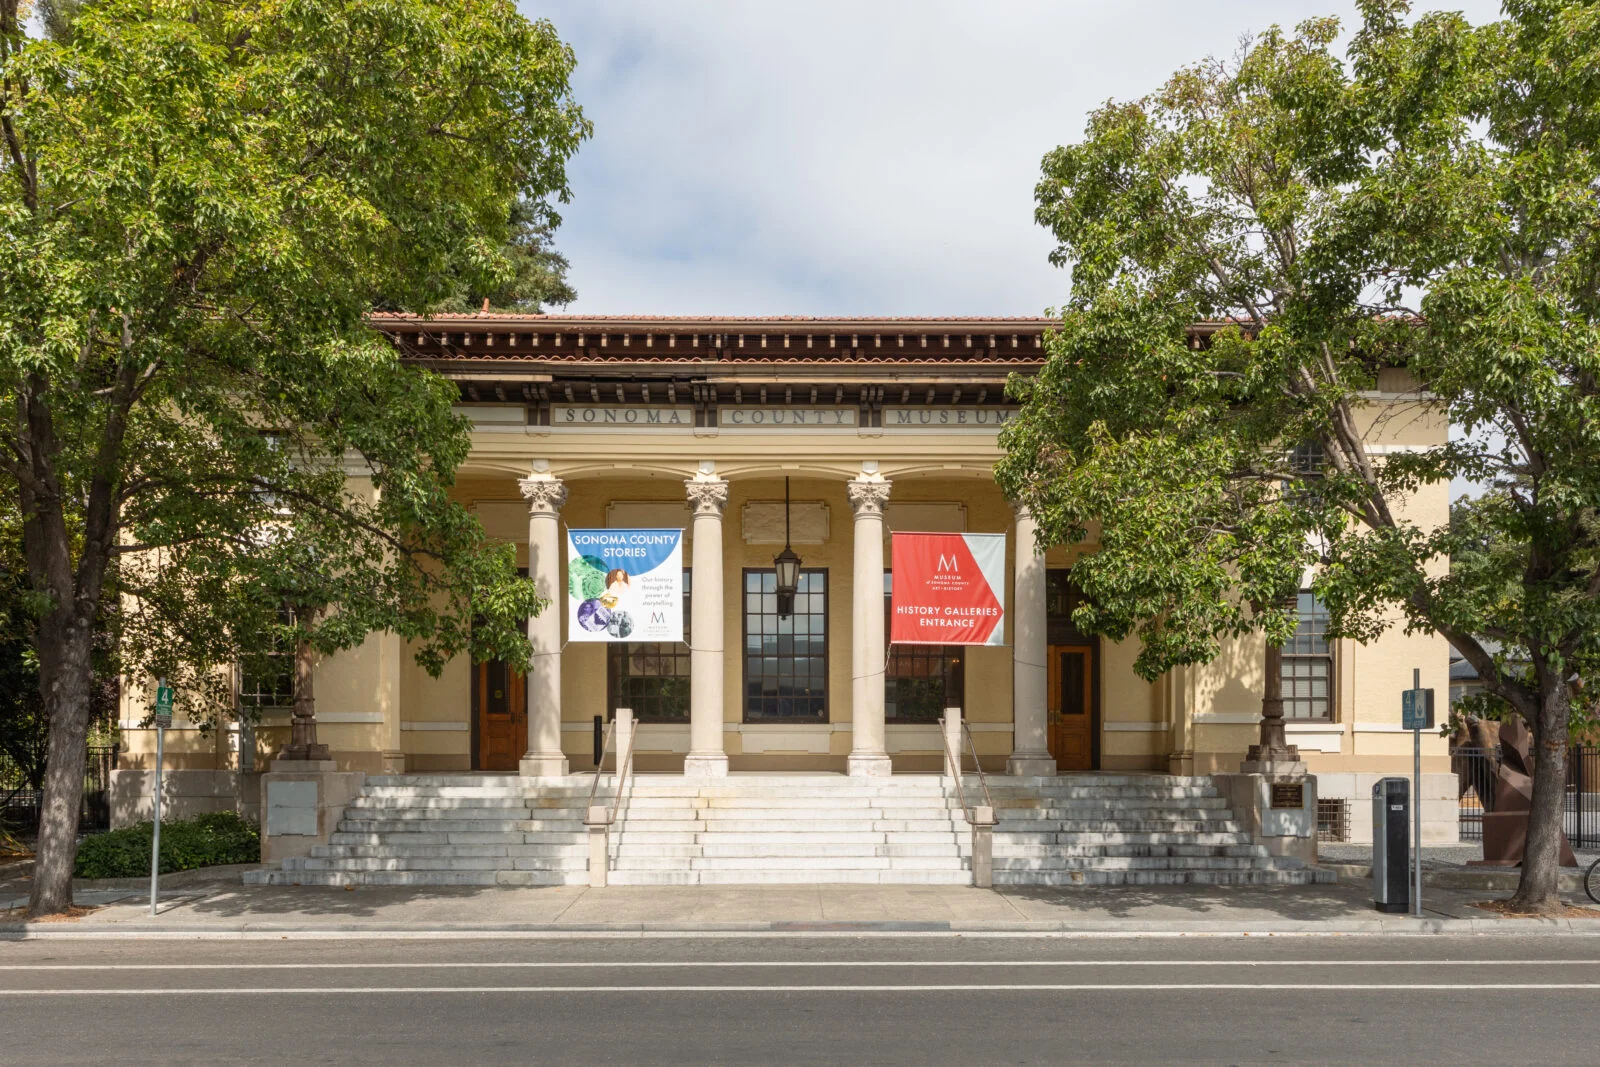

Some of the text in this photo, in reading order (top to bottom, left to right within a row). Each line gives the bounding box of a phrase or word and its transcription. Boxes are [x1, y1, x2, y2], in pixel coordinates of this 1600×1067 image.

[566, 409, 1010, 424] SONOMA COUNTY MUSEUM
[575, 535, 676, 545] SONOMA COUNTY
[603, 548, 647, 557] STORIES
[937, 553, 959, 572] M
[897, 606, 998, 616] HISTORY GALLERIES
[650, 611, 665, 624] M
[920, 618, 975, 628] ENTRANCE
[161, 689, 169, 705] 4
